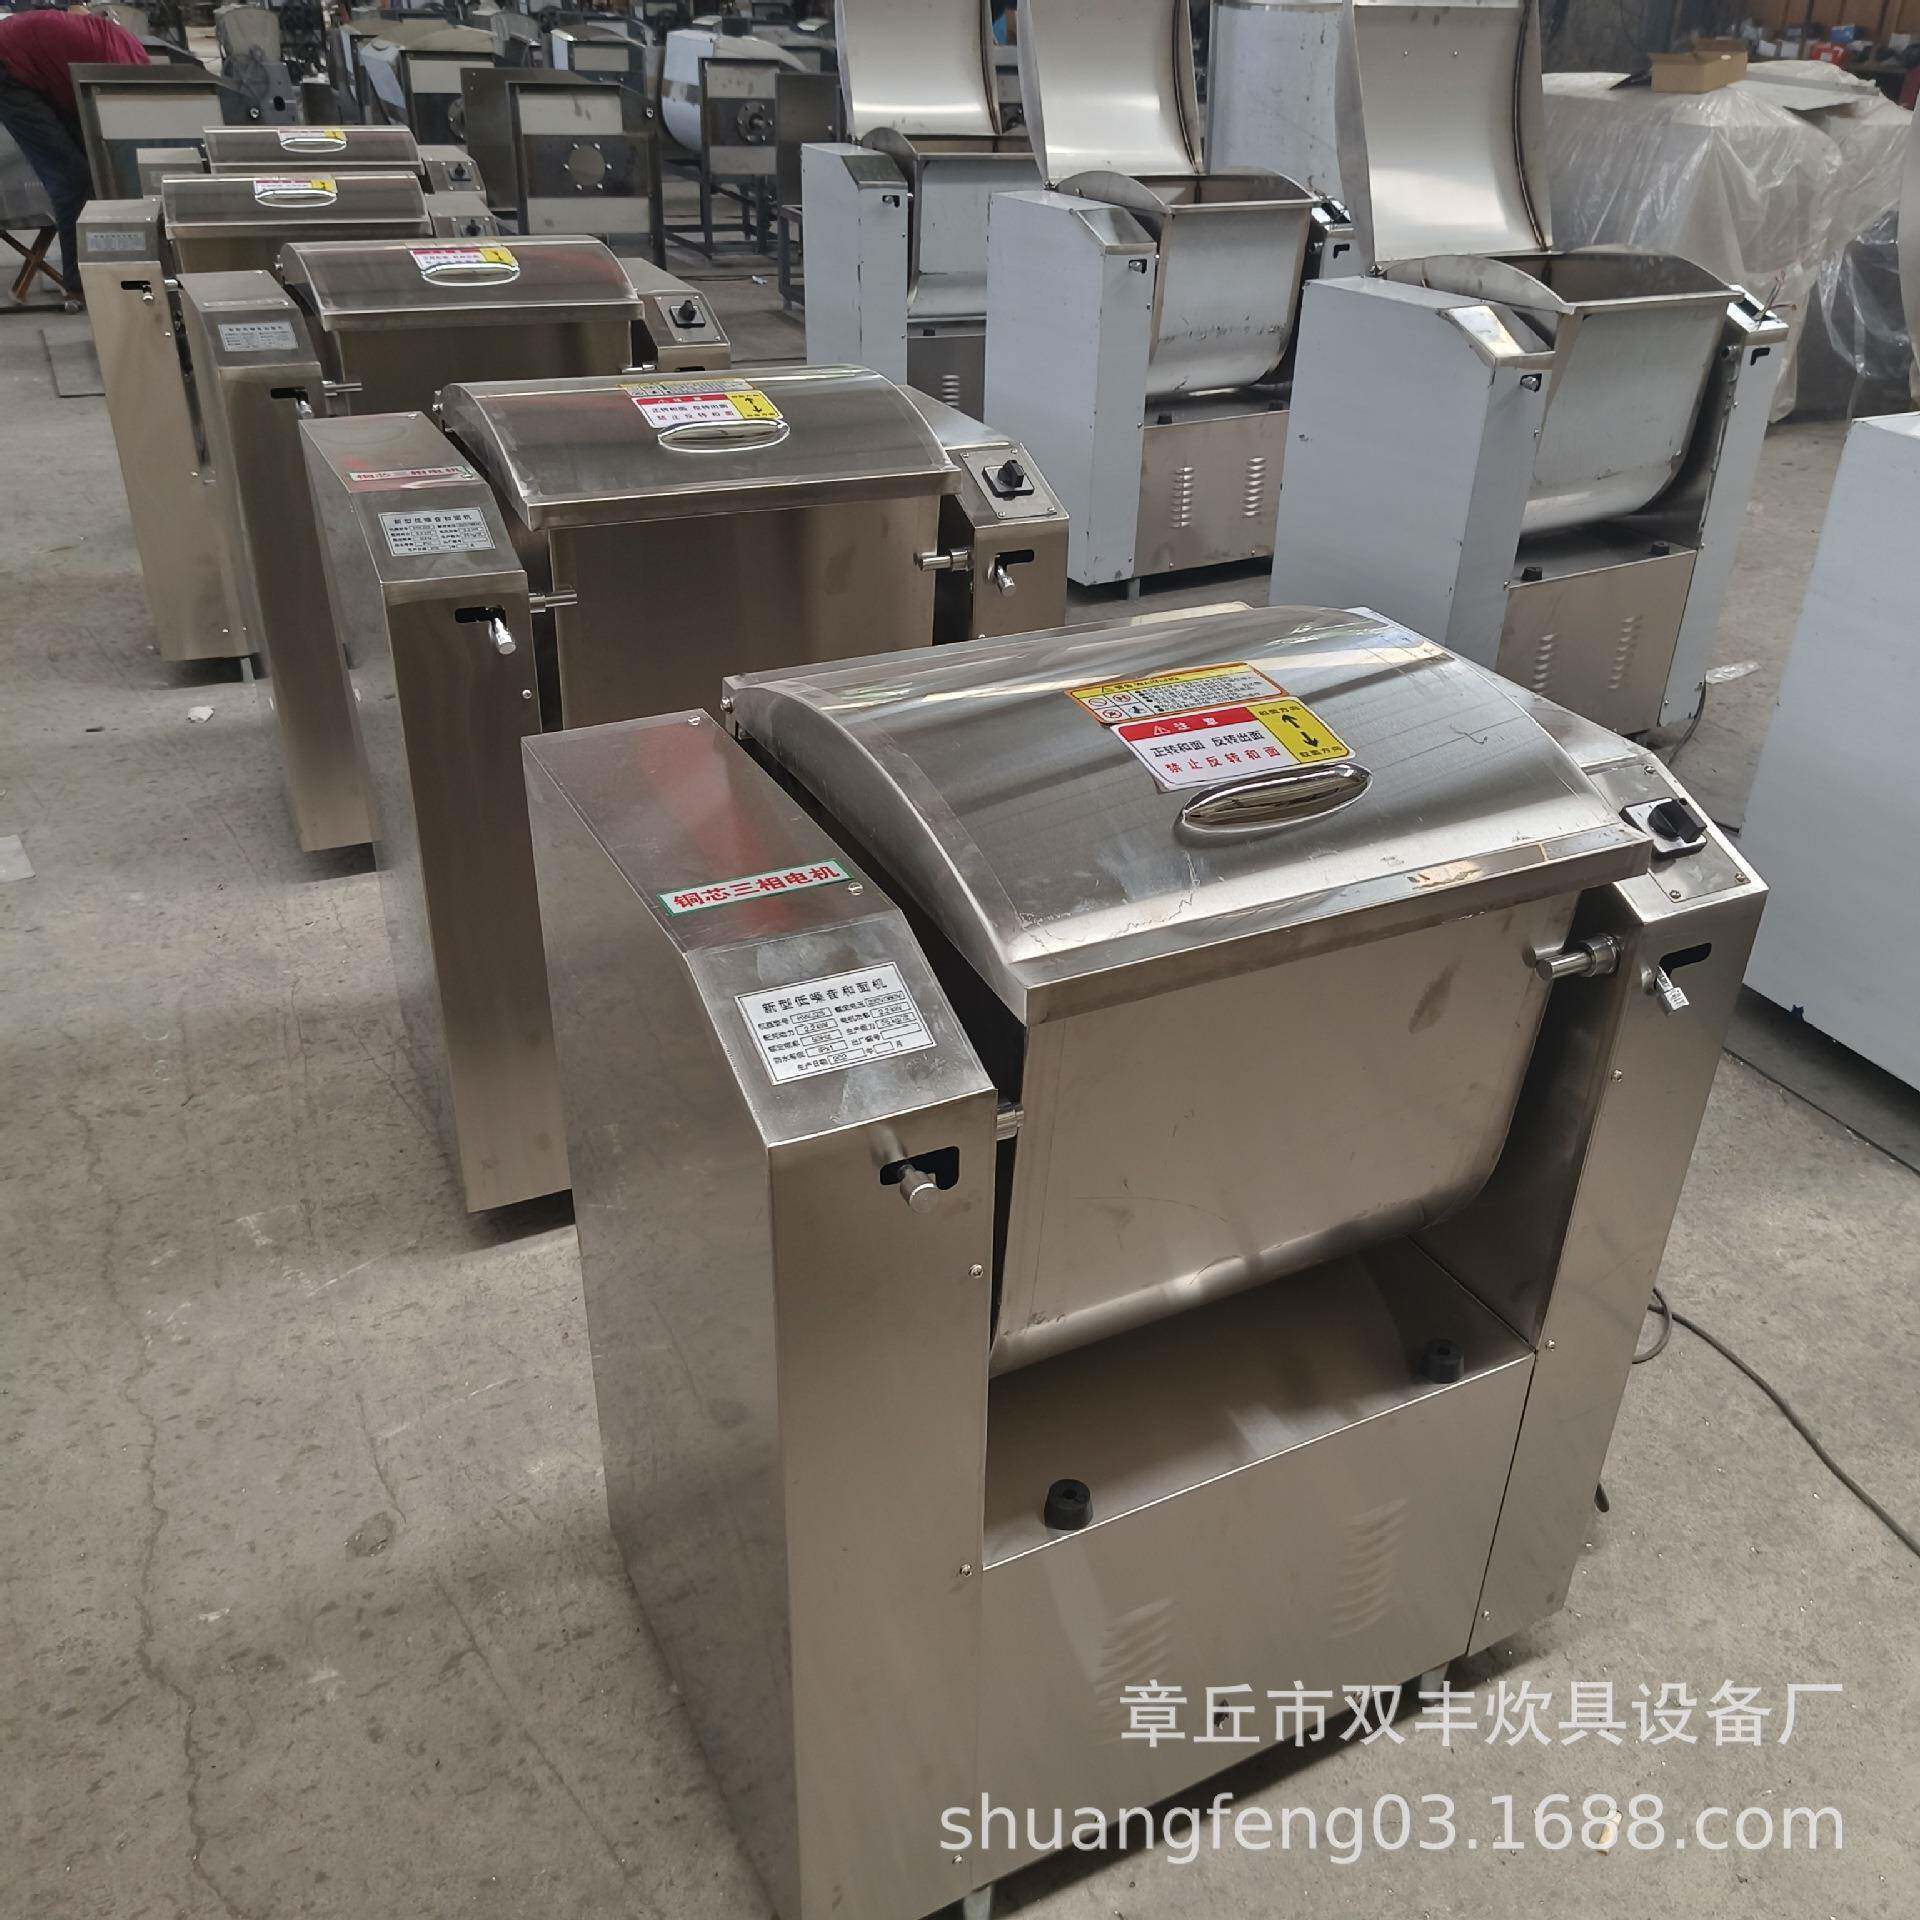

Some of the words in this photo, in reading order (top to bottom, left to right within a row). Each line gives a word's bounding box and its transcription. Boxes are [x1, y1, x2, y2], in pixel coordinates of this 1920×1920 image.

[1150, 740, 1206, 757] 正转和面
[1211, 731, 1264, 747] 反转出面
[1165, 746, 1280, 773] 禁止反转和面
[673, 866, 840, 908] 铜芯三相电机
[762, 977, 888, 1014] 新型低噪音和面机
